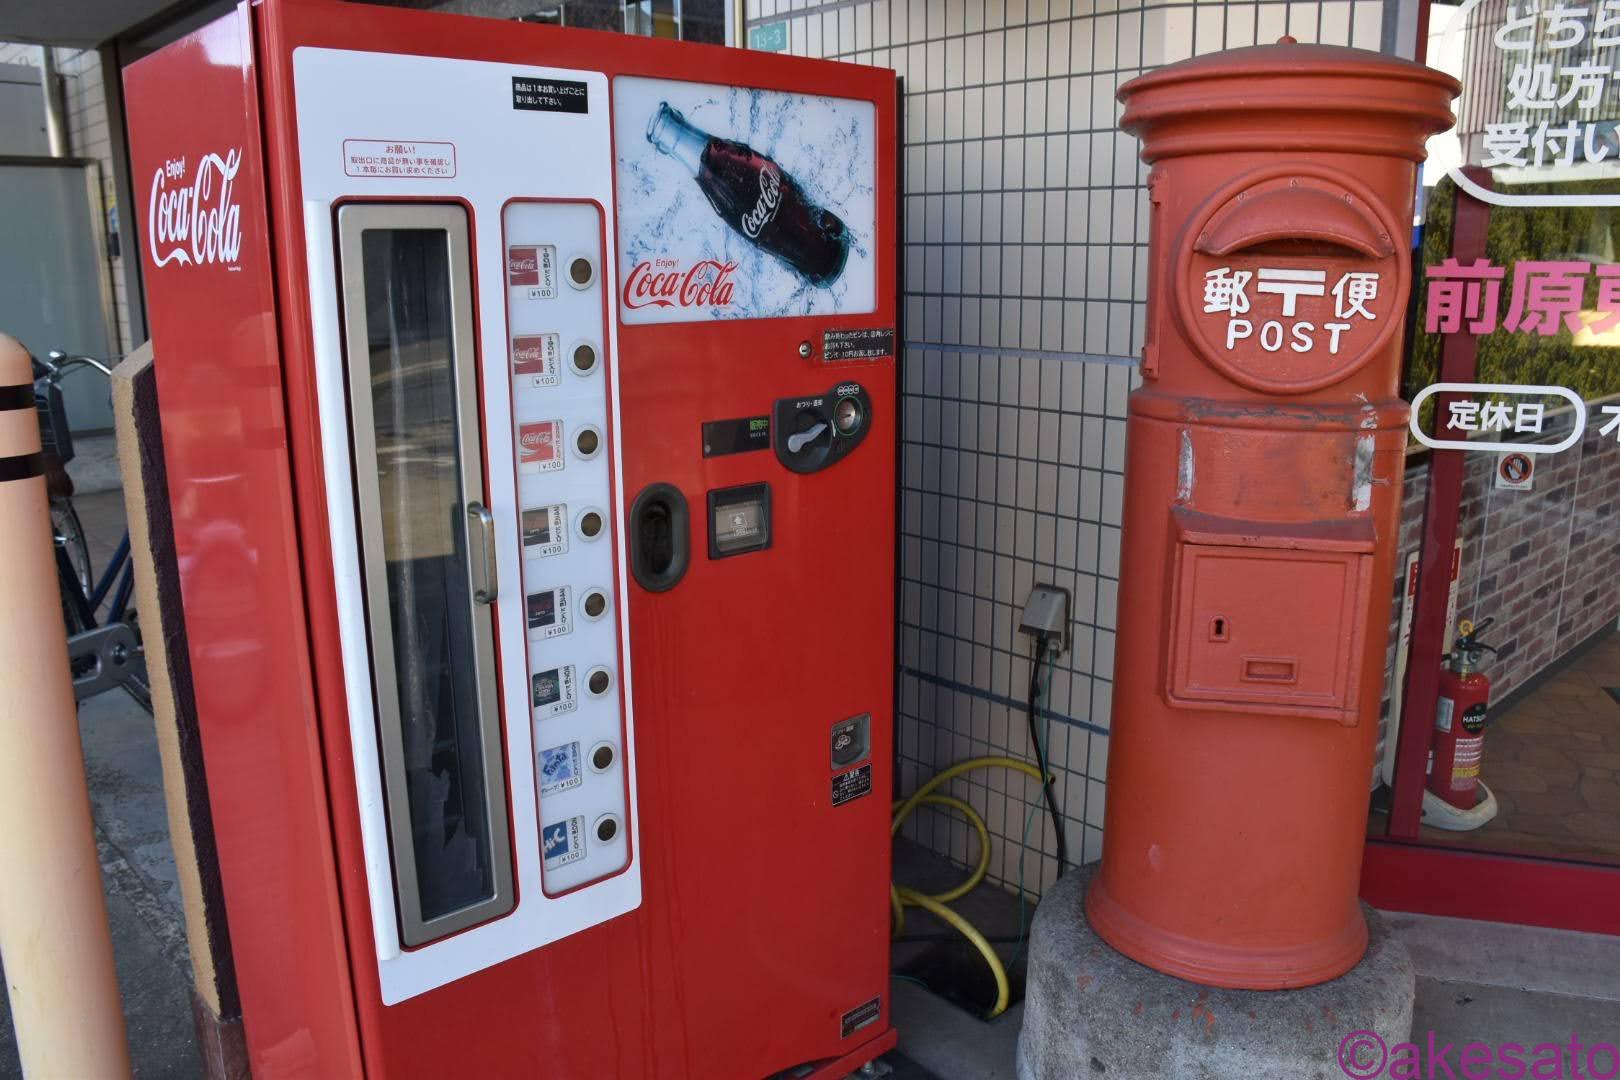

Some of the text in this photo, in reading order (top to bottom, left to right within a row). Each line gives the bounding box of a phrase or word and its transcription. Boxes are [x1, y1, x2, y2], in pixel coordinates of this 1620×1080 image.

[1506, 61, 1620, 110] 処方
[166, 155, 185, 180] Enjoy!
[149, 145, 242, 268] Coca-Cola
[741, 160, 782, 238] Coca-Cola
[655, 258, 680, 268] Enjoy!
[531, 289, 552, 298] ¥100
[623, 260, 739, 310] Coca-Cola
[1226, 319, 1351, 355] POST
[1446, 400, 1545, 434] 定休日
[542, 461, 561, 470] ¥100
[542, 545, 562, 555] ¥100
[547, 626, 567, 637] ¥100
[553, 702, 573, 713] ¥100
[542, 752, 568, 776] Fanta
[561, 777, 580, 788] ¥100
